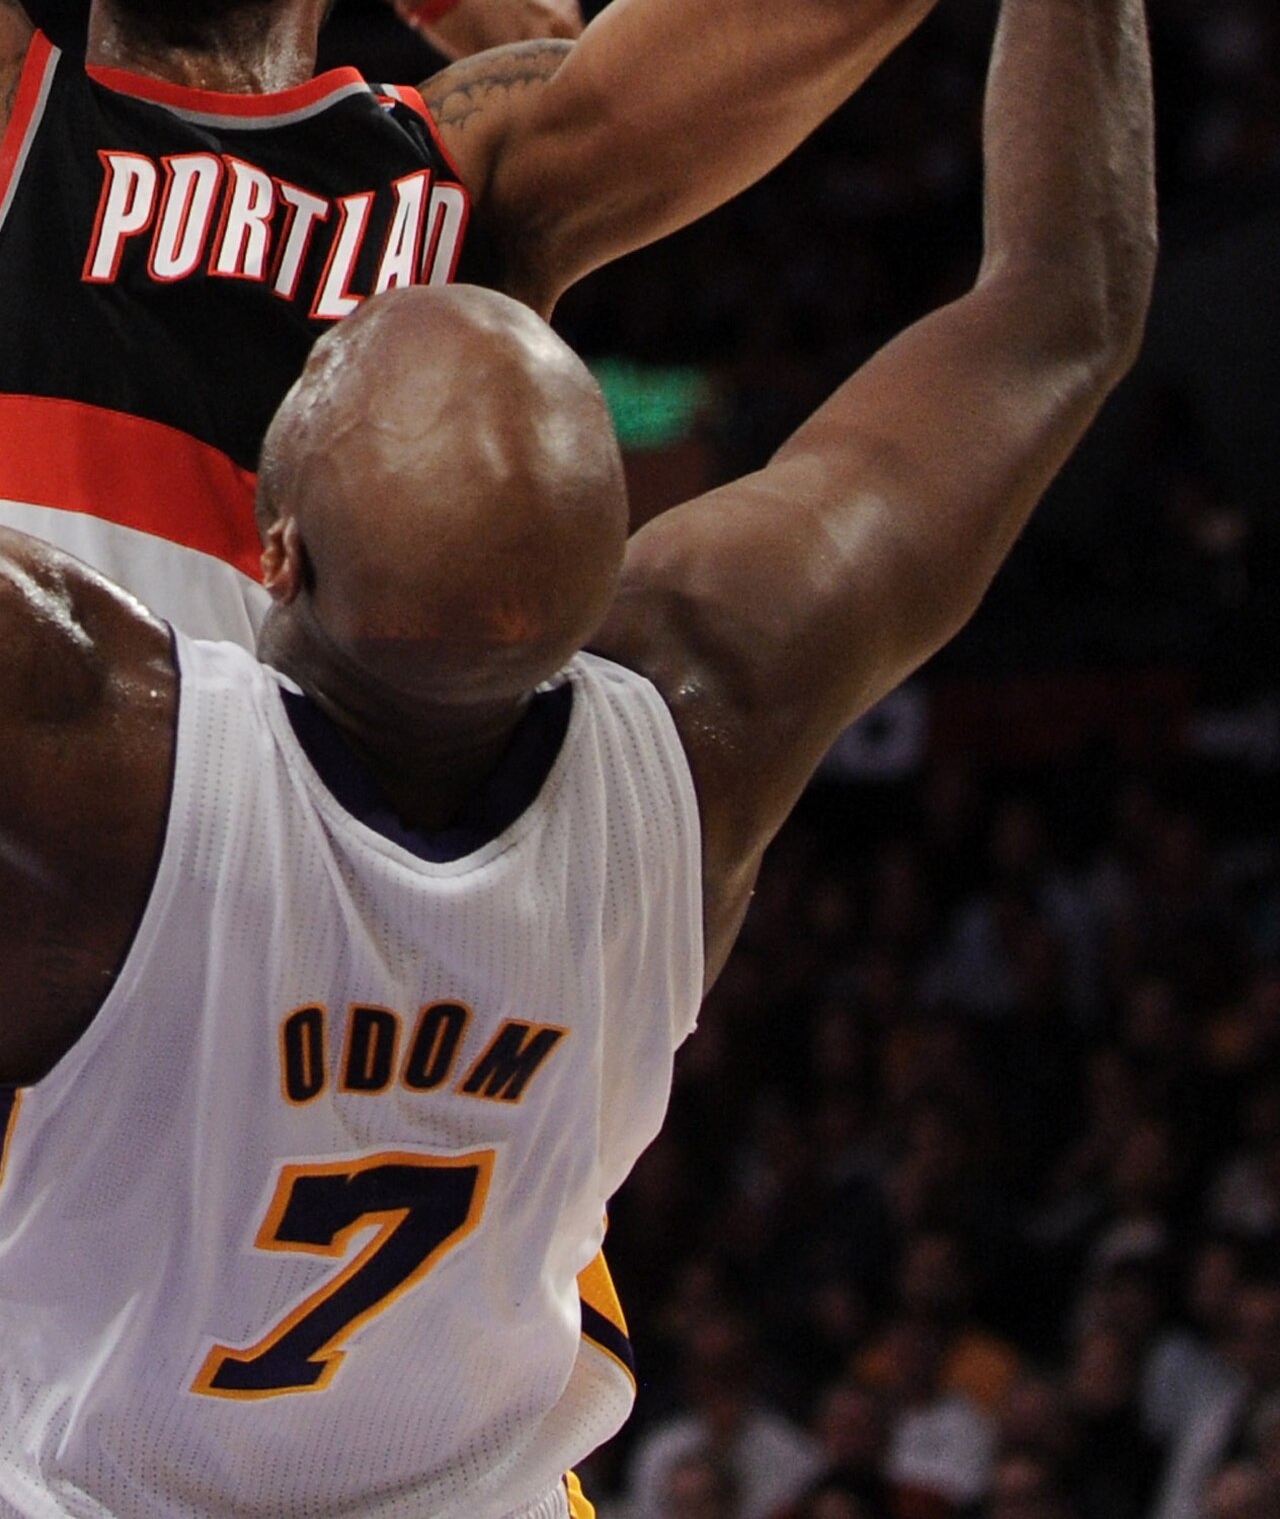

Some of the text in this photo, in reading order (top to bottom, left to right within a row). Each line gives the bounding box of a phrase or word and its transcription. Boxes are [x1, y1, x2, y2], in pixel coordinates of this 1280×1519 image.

[82, 150, 470, 319] PORTLAD
[279, 999, 571, 1108] ODOM
[189, 1148, 496, 1400] 7
